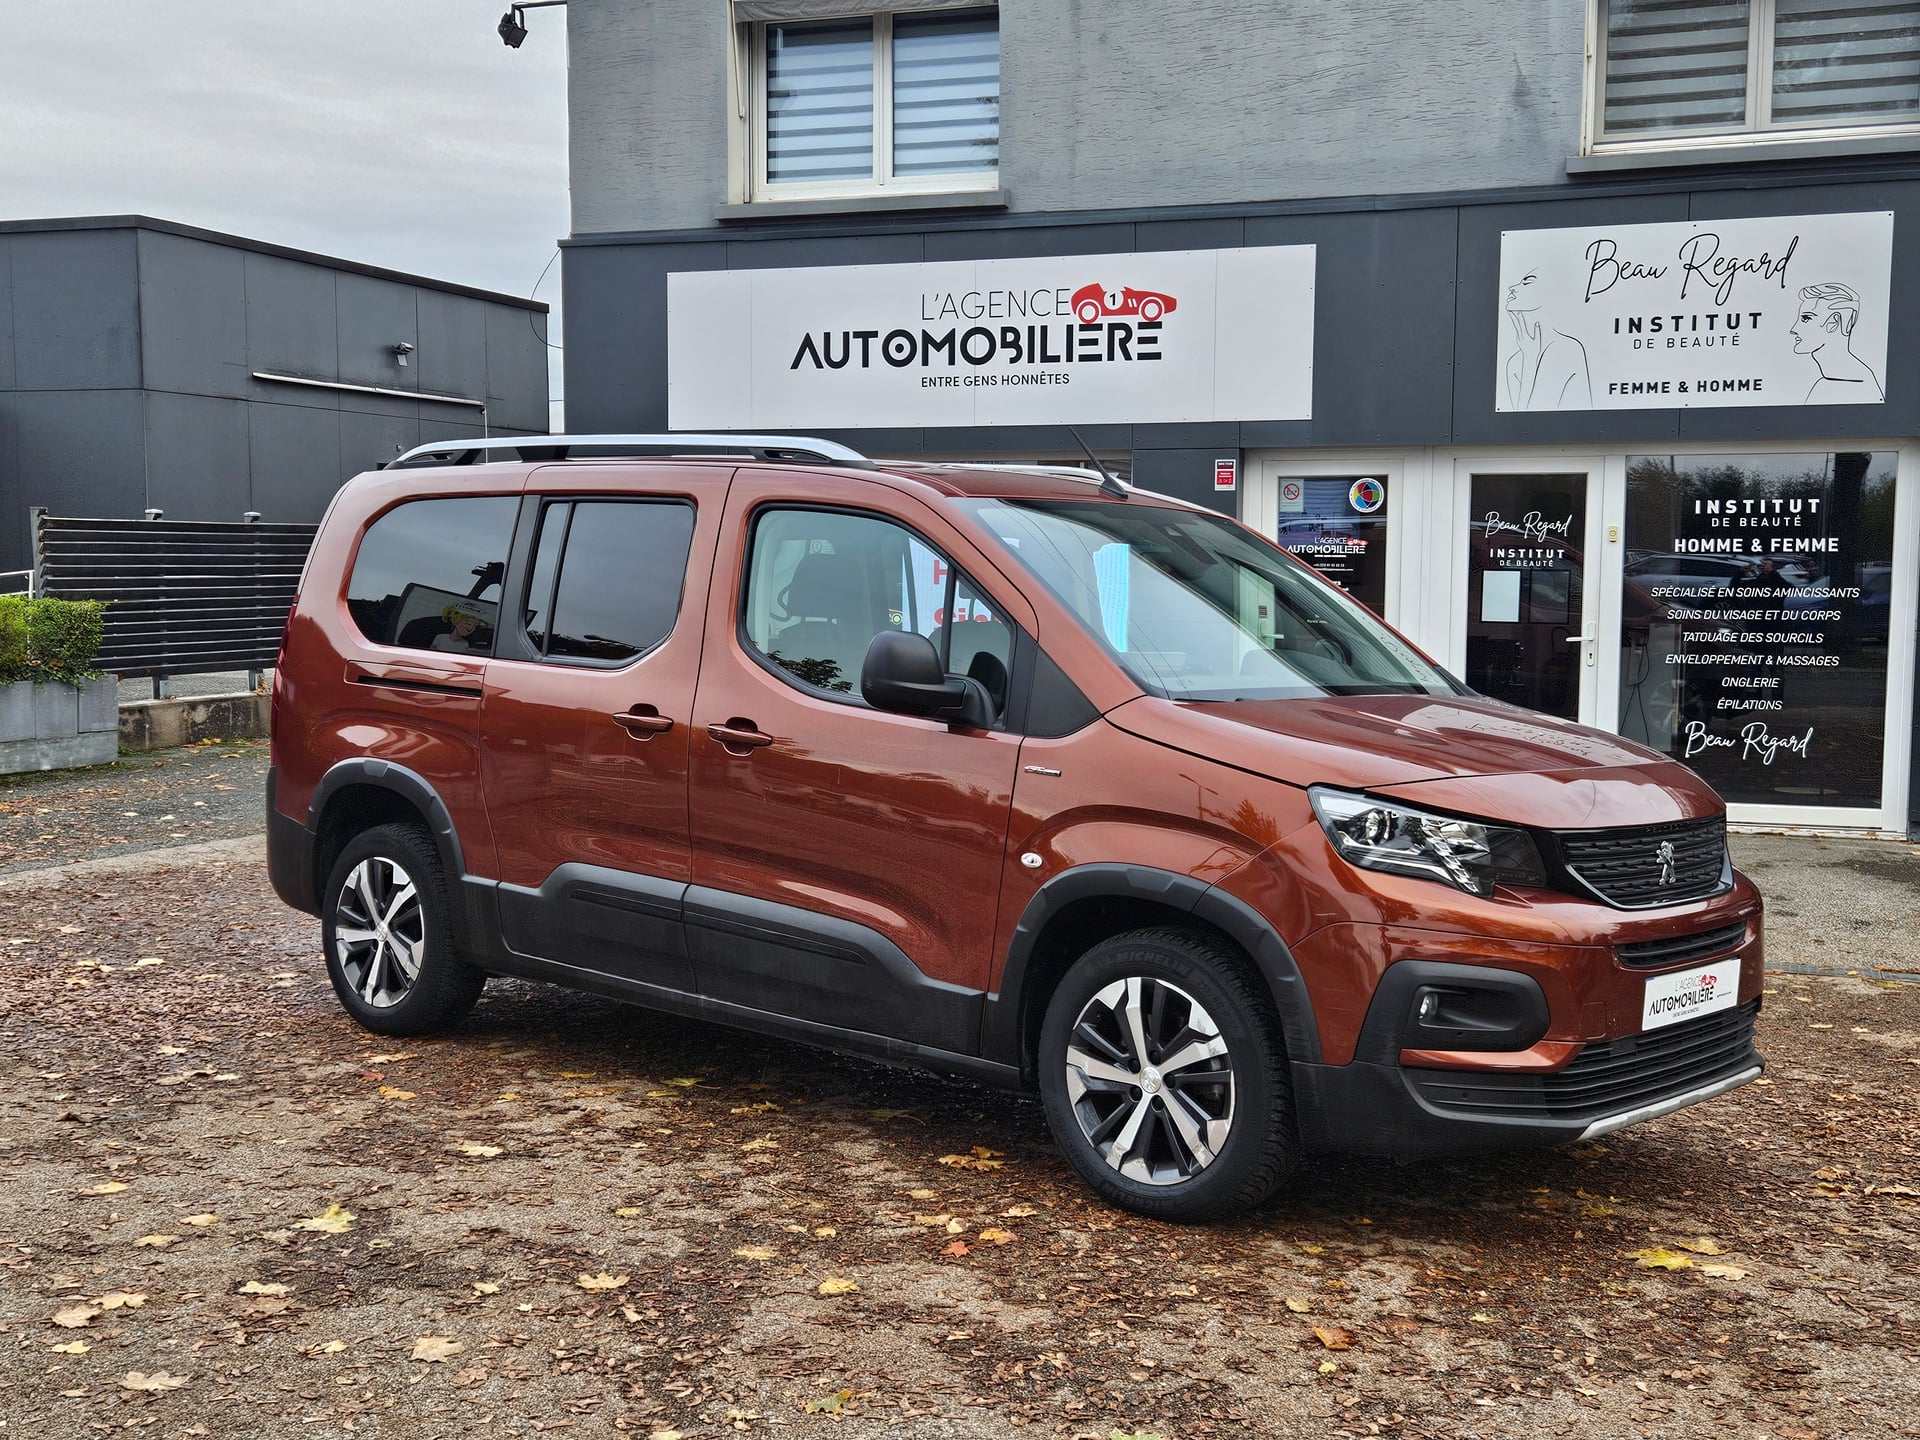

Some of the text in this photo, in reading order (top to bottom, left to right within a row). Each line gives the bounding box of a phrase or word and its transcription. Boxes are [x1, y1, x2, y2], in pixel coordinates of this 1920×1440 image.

[1585, 233, 1799, 306] Beau Regard
[921, 289, 1071, 321] L'AGENCE
[1614, 313, 1763, 334] INSTITUT
[1634, 333, 1739, 349] DE BEAUTÉ
[922, 371, 1069, 387] ENTRE GENS HONNÊTES
[1609, 379, 1762, 394] FEMME & HOMME
[1695, 498, 1820, 514] INSTITUT
[1485, 511, 1572, 542] Beau Regard
[1712, 515, 1801, 527] DE BEAUTÉ
[1674, 538, 1838, 552] HOMME & FEMME
[1490, 549, 1565, 558] INSTITUT
[1516, 559, 1553, 567] BEAUTÉ
[1651, 585, 1860, 597] SPÉCIALISÉ EN SOINS AMINCISSANTS
[1667, 608, 1841, 620] SOINS DU VISAGE ET DU CORPS
[1683, 630, 1824, 643] TATOUAGE DES SOURCILS
[1665, 654, 1839, 666] ENVELOPPEMENT & MASSAGES
[1722, 677, 1780, 687] ONGLERIE
[1717, 697, 1782, 710] ÉPILATIONS
[1685, 721, 1813, 765] Beau Regard
